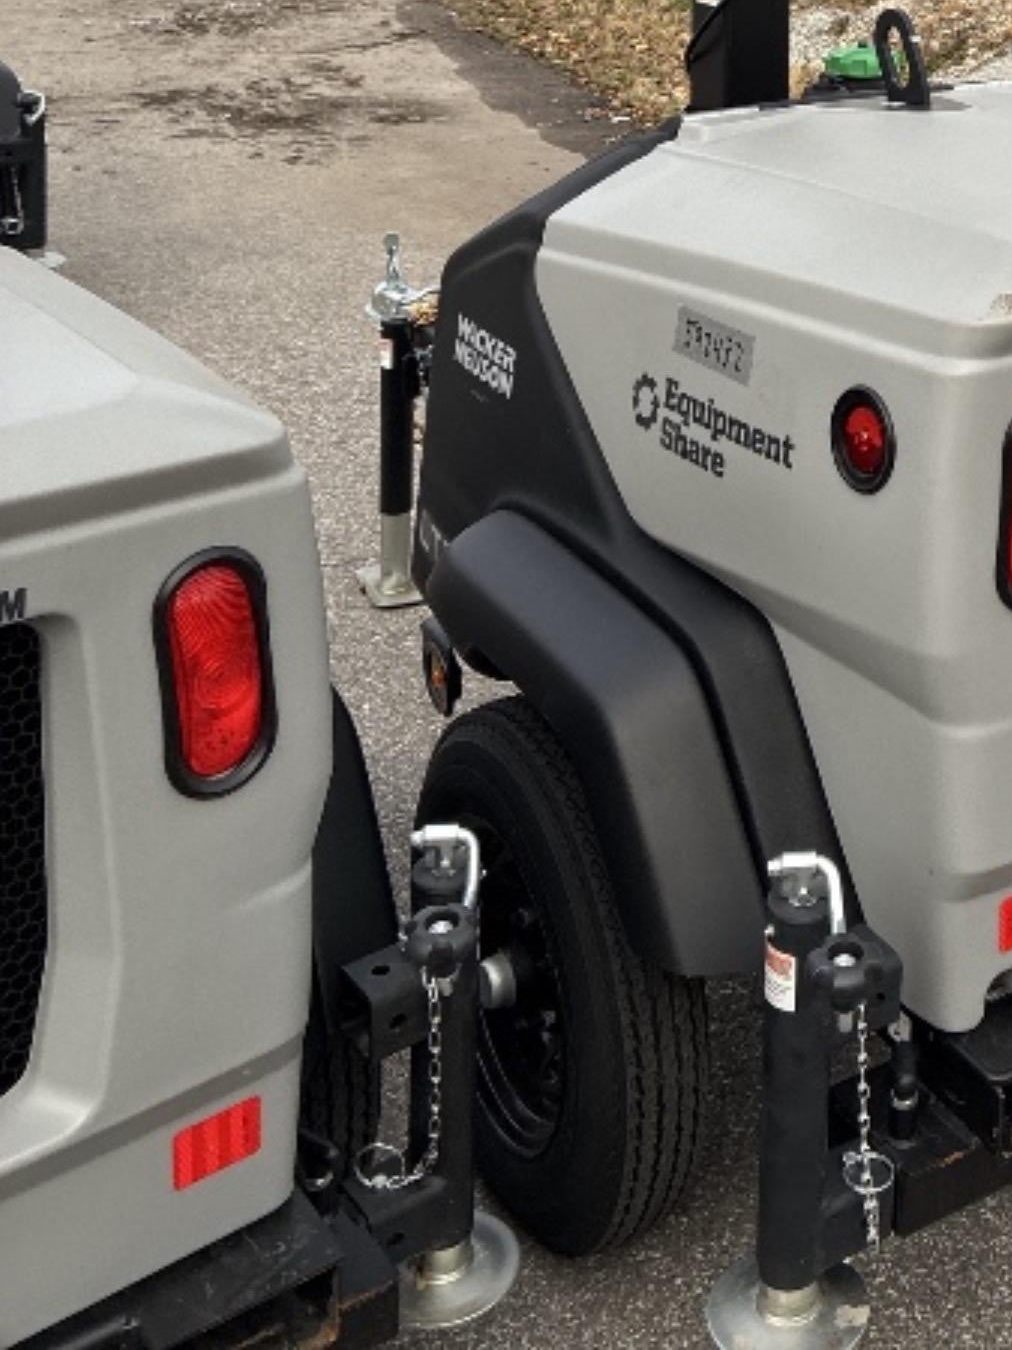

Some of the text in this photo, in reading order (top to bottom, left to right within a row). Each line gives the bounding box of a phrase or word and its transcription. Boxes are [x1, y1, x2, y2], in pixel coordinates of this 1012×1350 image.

[453, 338, 514, 399] NEUSON
[457, 313, 517, 372] WACKER
[660, 416, 725, 478] Share
[663, 377, 796, 468] Equipment
